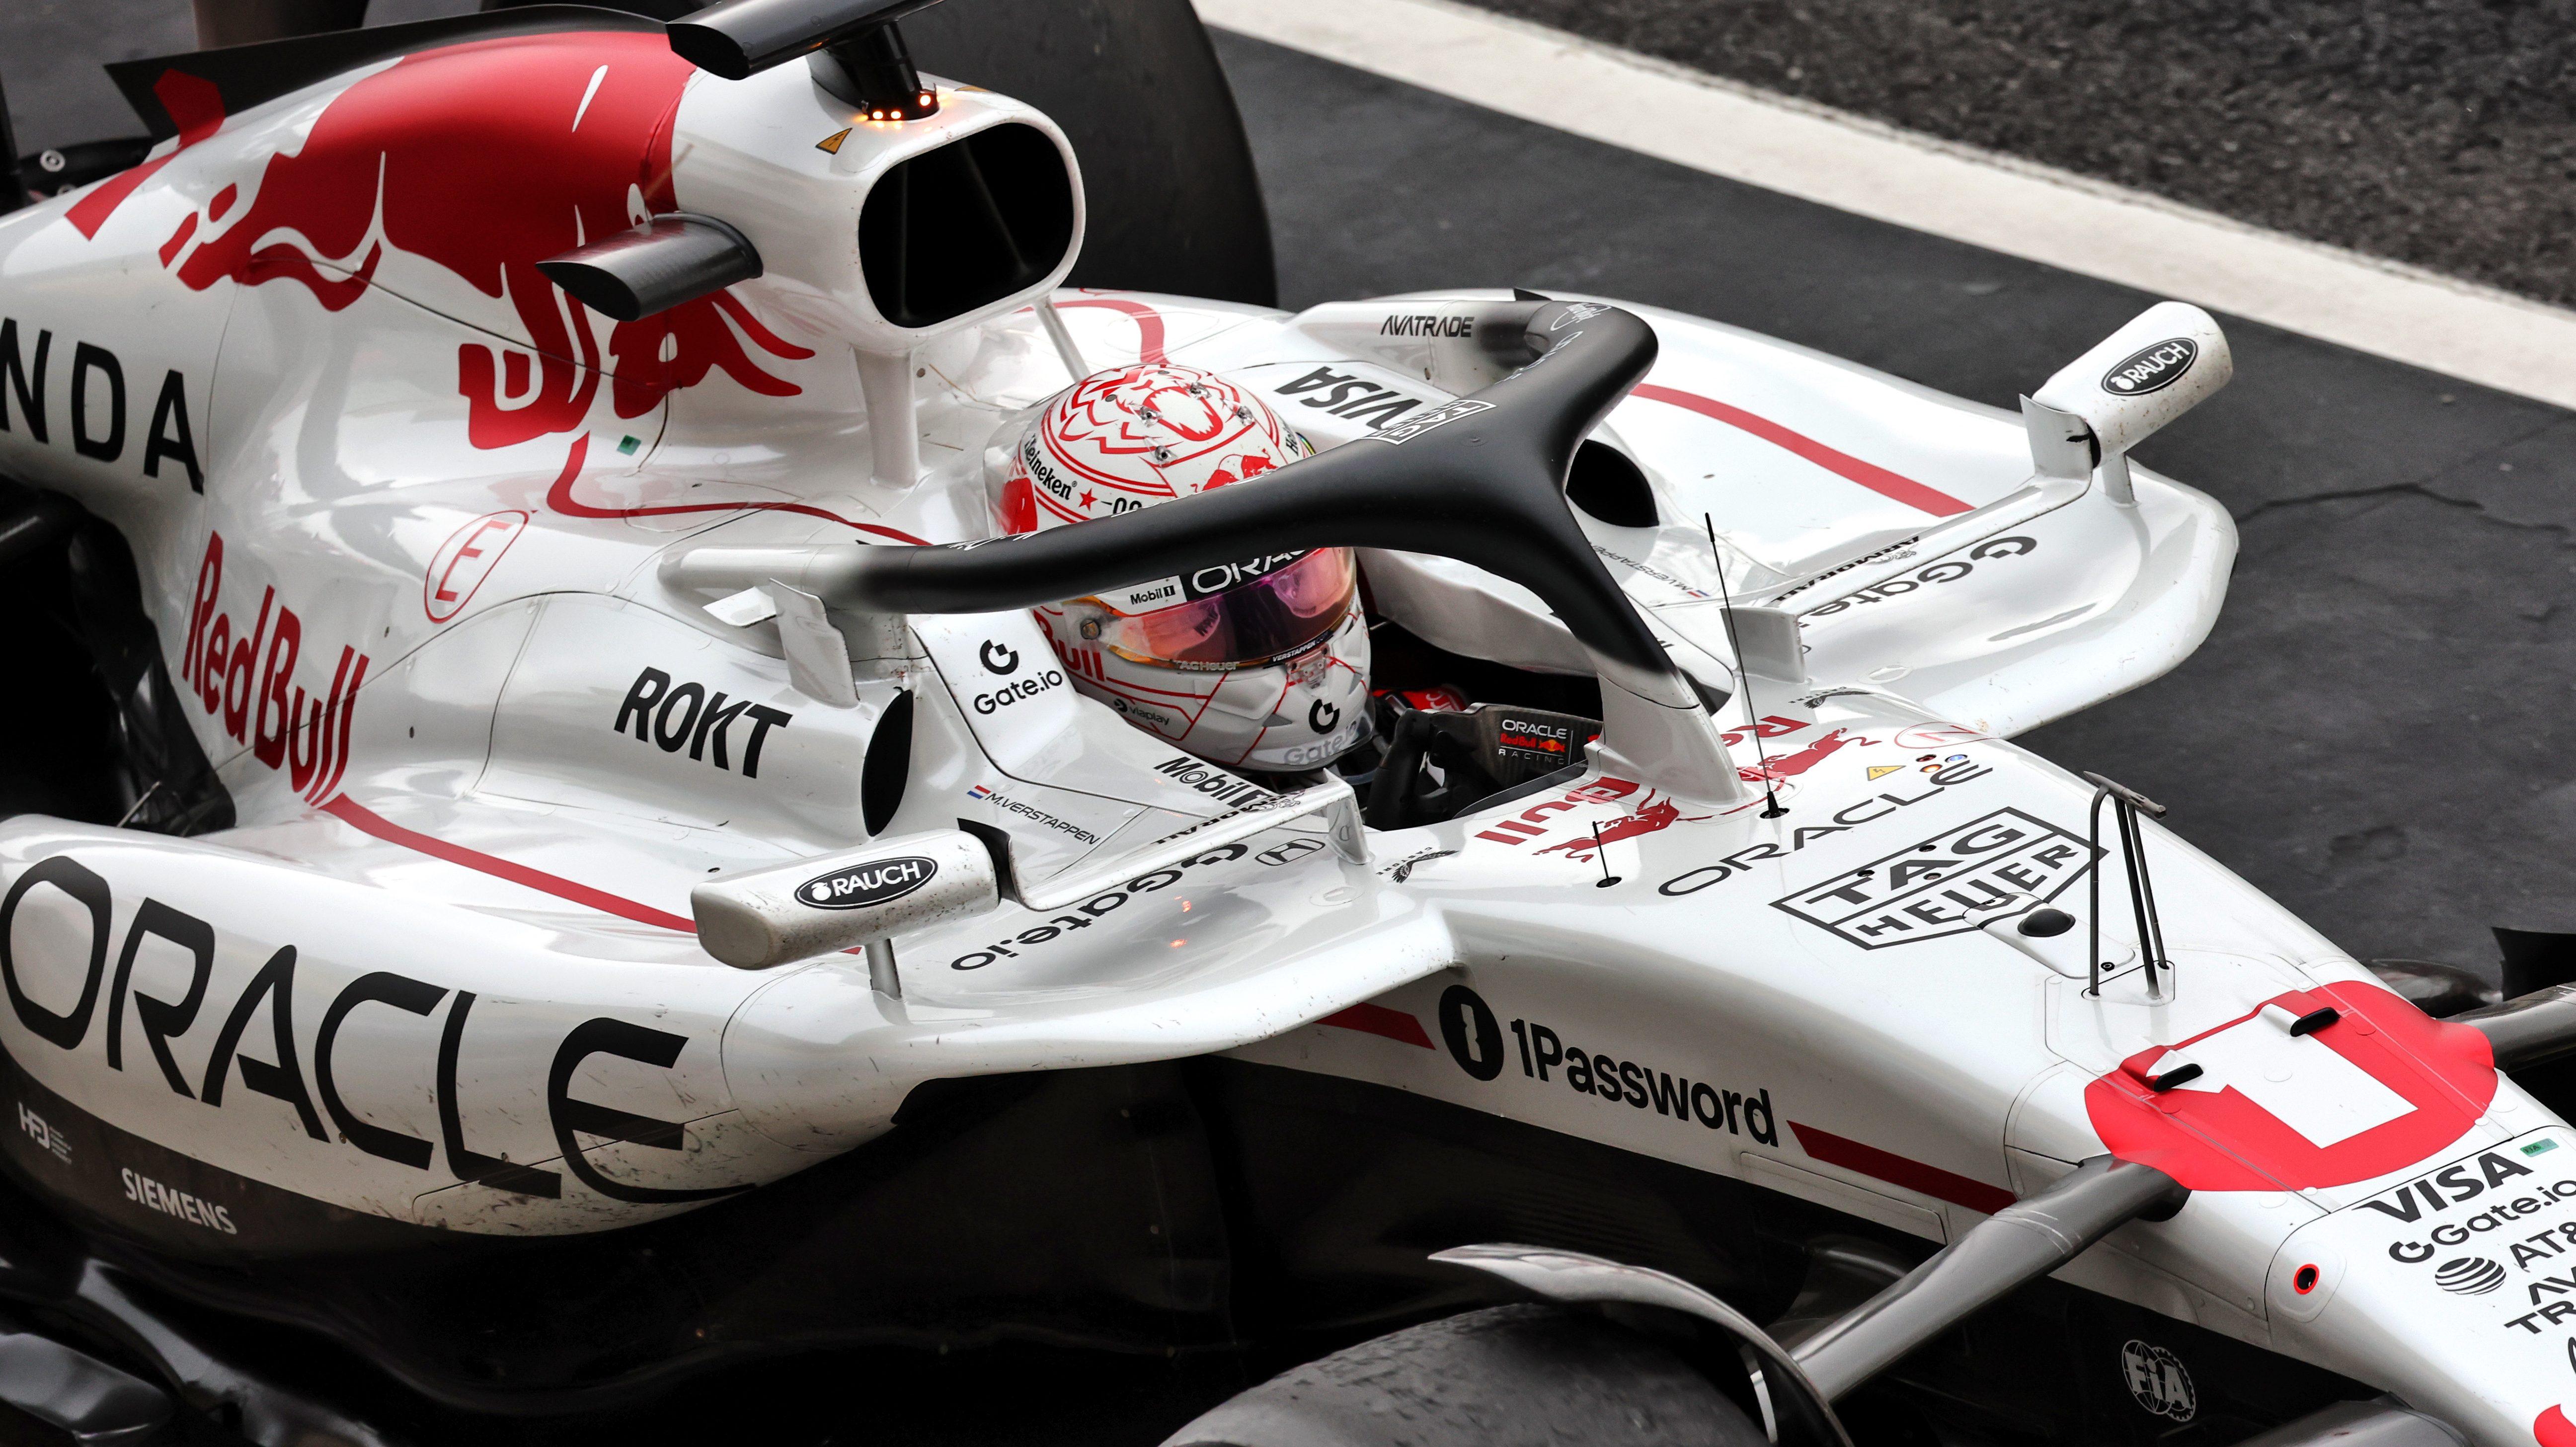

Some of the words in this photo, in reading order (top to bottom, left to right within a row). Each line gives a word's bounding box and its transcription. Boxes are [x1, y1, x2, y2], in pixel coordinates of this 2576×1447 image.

[1381, 315, 1474, 337] AVATRADE
[2126, 342, 2190, 384] RAUCH
[1274, 366, 1423, 431] VISA
[1130, 590, 1163, 605] Mobil
[614, 666, 792, 779] ROKT
[973, 669, 1063, 715] Gate.io
[1502, 720, 1567, 739] ORACLE
[986, 792, 1100, 844] M.VERSTAPPEN
[1658, 760, 1993, 896] ORACLE
[832, 860, 922, 897] RAUCH
[1805, 824, 2027, 905] TAG
[1856, 844, 2079, 937] HEUER
[951, 869, 1183, 971] Gate.io
[0, 855, 756, 1204] ORACLE
[1510, 1018, 1779, 1148] 1Password
[121, 1168, 237, 1235] SIEMENS
[2351, 1151, 2534, 1223] VISA
[2431, 1180, 2576, 1245] Gate.io
[2124, 1351, 2192, 1409] FIA
